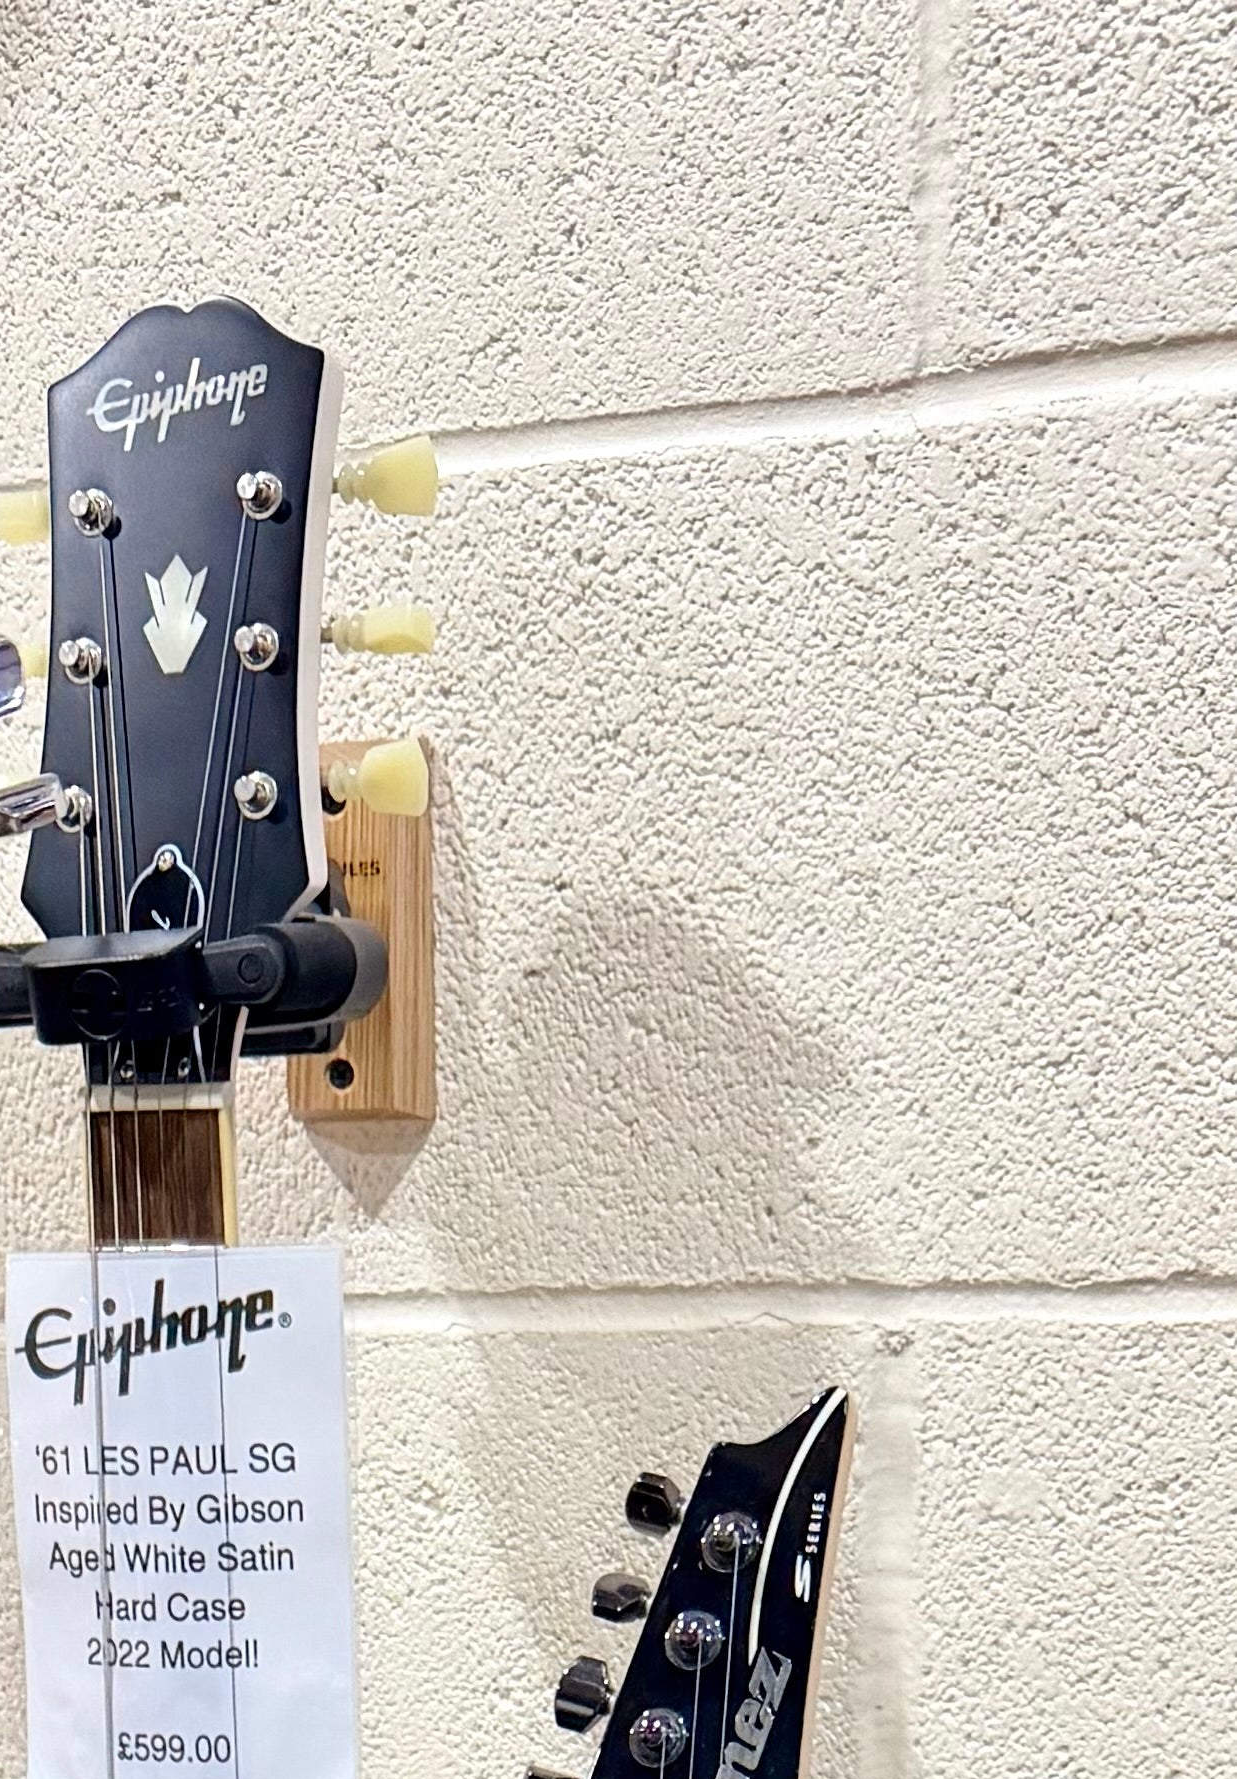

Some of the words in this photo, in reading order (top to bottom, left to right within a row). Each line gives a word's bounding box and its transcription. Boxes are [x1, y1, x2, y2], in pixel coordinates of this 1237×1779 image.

[86, 357, 268, 451] Epiphone
[84, 1446, 140, 1477] LES
[150, 1444, 238, 1476] PAUL
[248, 1442, 297, 1474] SG
[35, 1495, 138, 1529] Inspired
[149, 1495, 186, 1531] By
[196, 1494, 304, 1526] Gibson
[804, 1491, 828, 1555] SERIES
[49, 1542, 116, 1578] Aged
[124, 1542, 206, 1574] White
[218, 1541, 295, 1573] Satin
[96, 1591, 157, 1623] Hard
[167, 1592, 246, 1622] Case
[87, 1638, 150, 1669] 2022
[161, 1638, 260, 1669] Model!
[118, 1733, 232, 1764] £599.00
